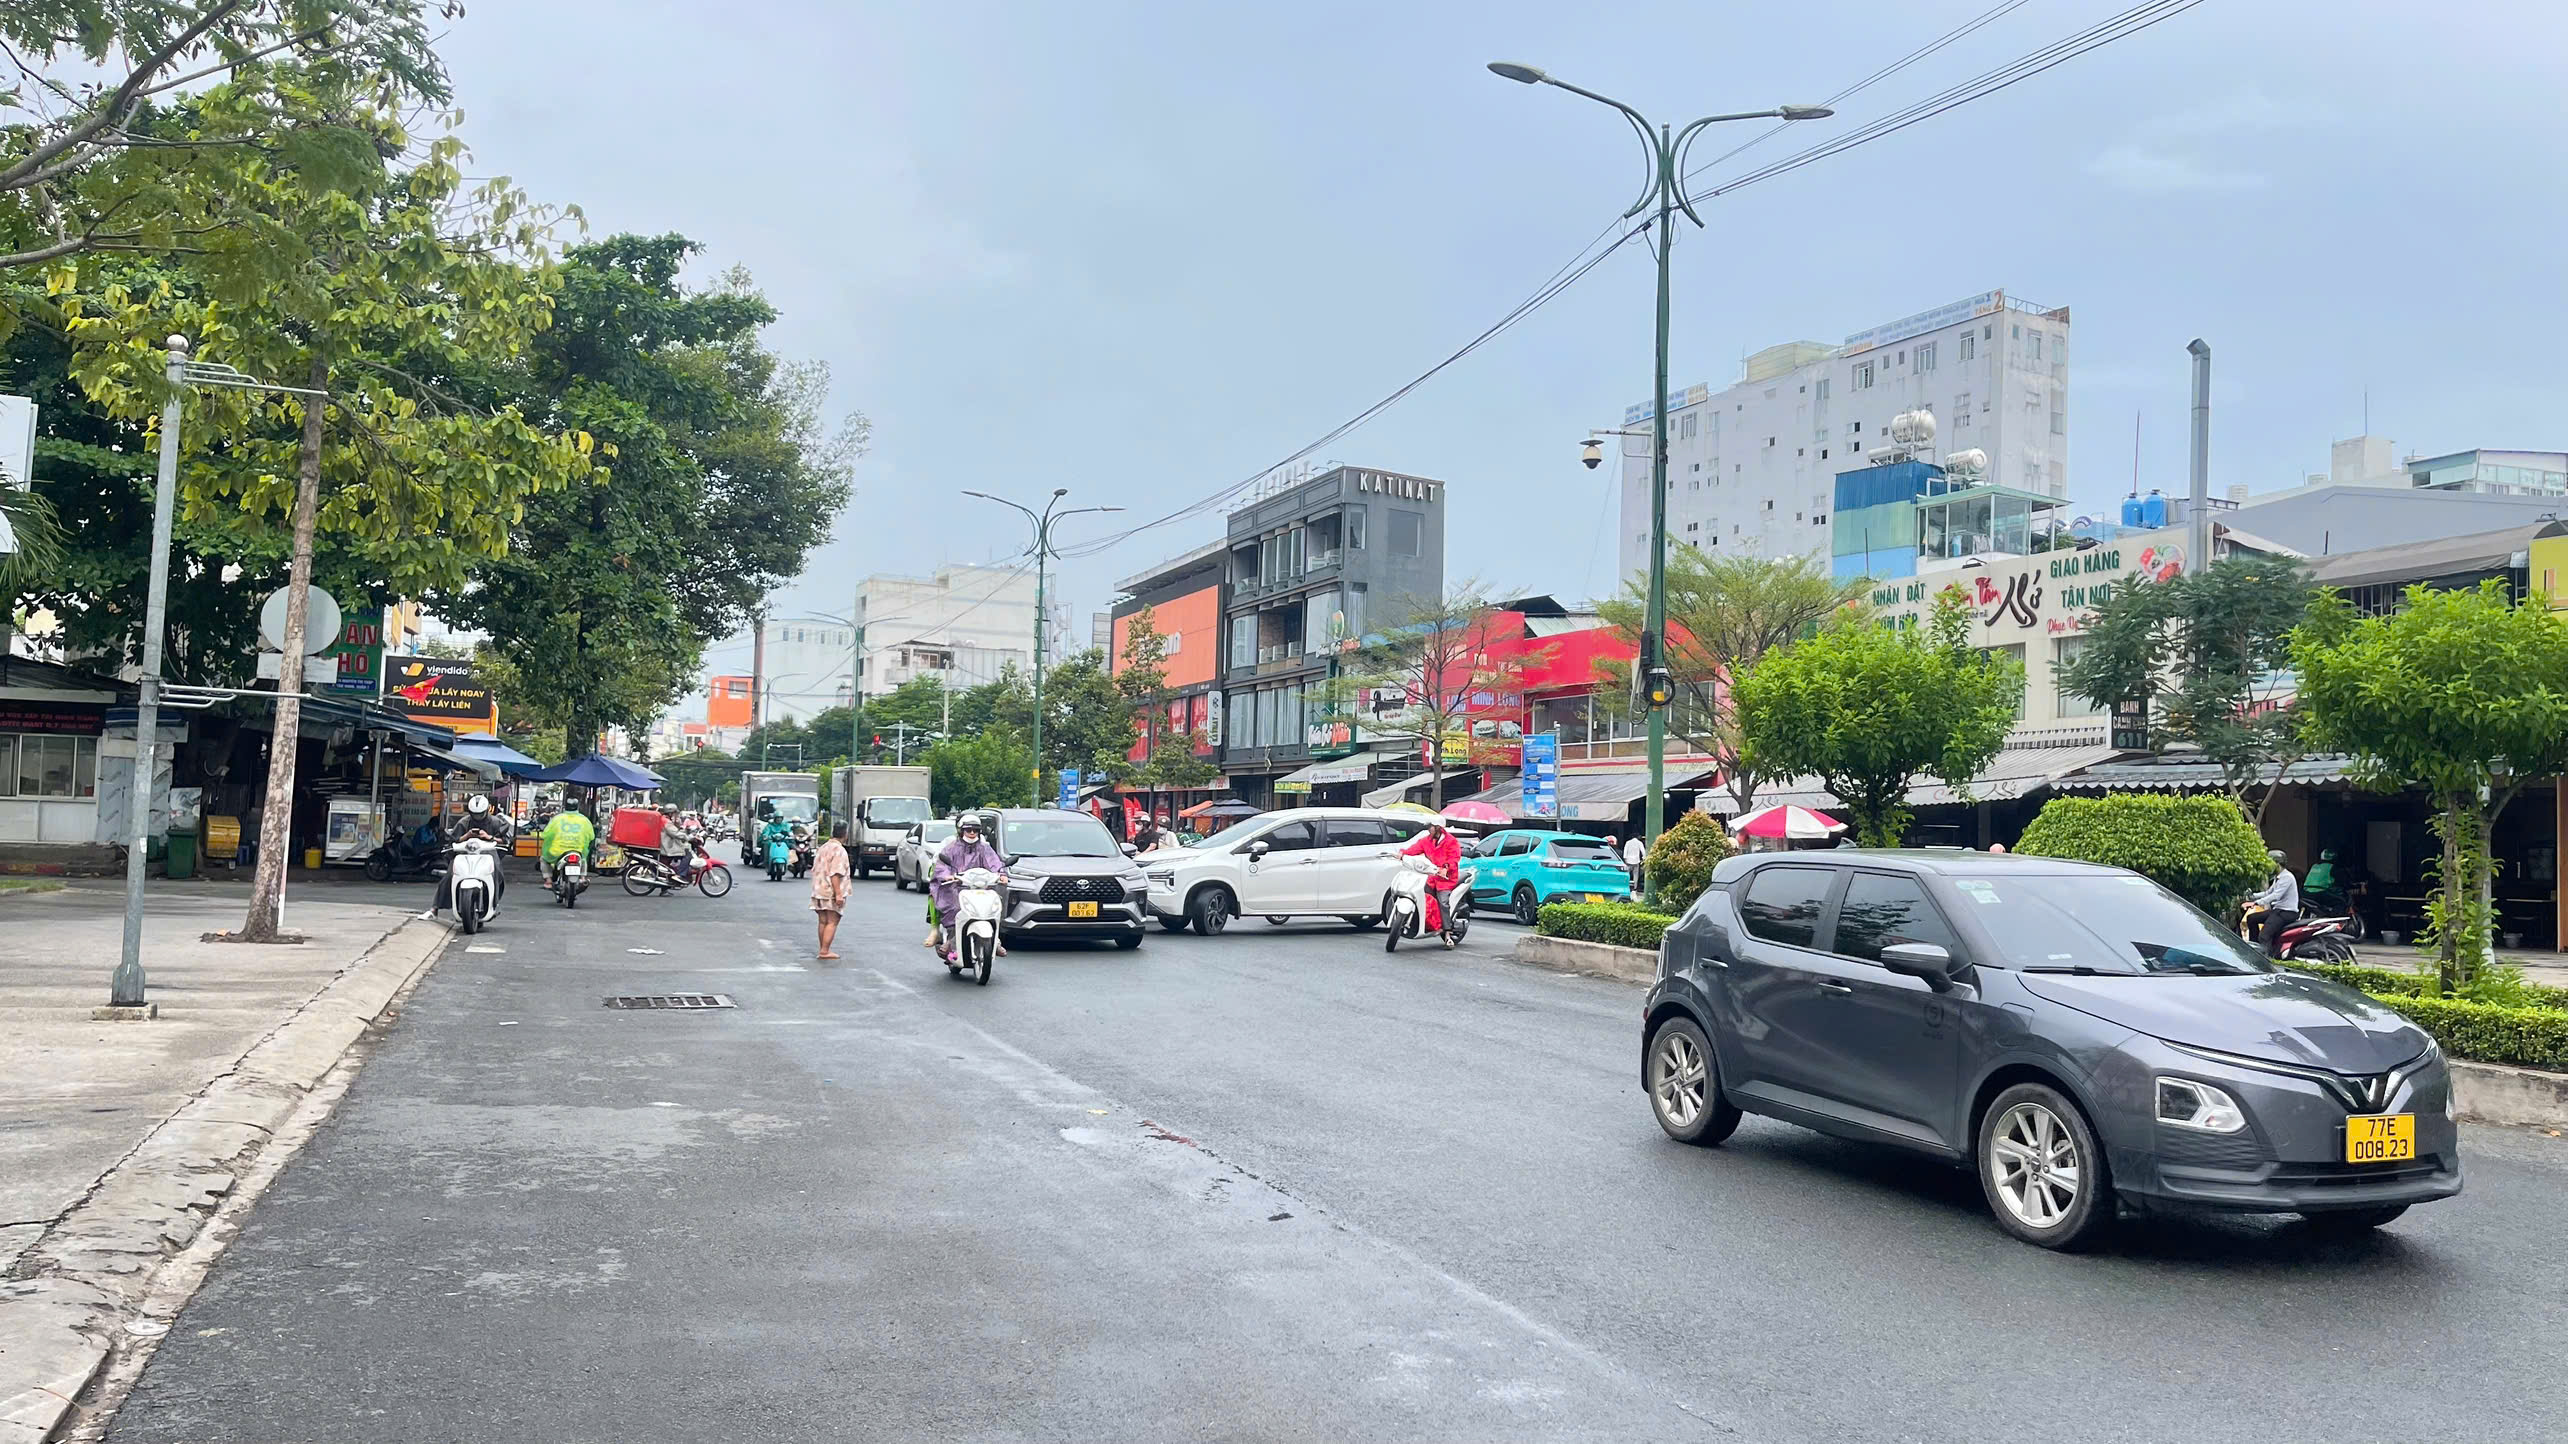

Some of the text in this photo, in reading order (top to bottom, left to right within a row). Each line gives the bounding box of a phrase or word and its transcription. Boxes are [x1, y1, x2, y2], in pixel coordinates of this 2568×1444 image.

[1359, 471, 1437, 502] KATINAT
[2051, 548, 2120, 578] GIAO HÀNG
[1872, 581, 1926, 608] NHẬN ĐẶT
[2061, 584, 2085, 612] TẬN
[2117, 732, 2143, 748] 611
[1561, 805, 1579, 818] ONG
[2367, 1117, 2397, 1137] 77E
[2355, 1138, 2408, 1160] 008.23
